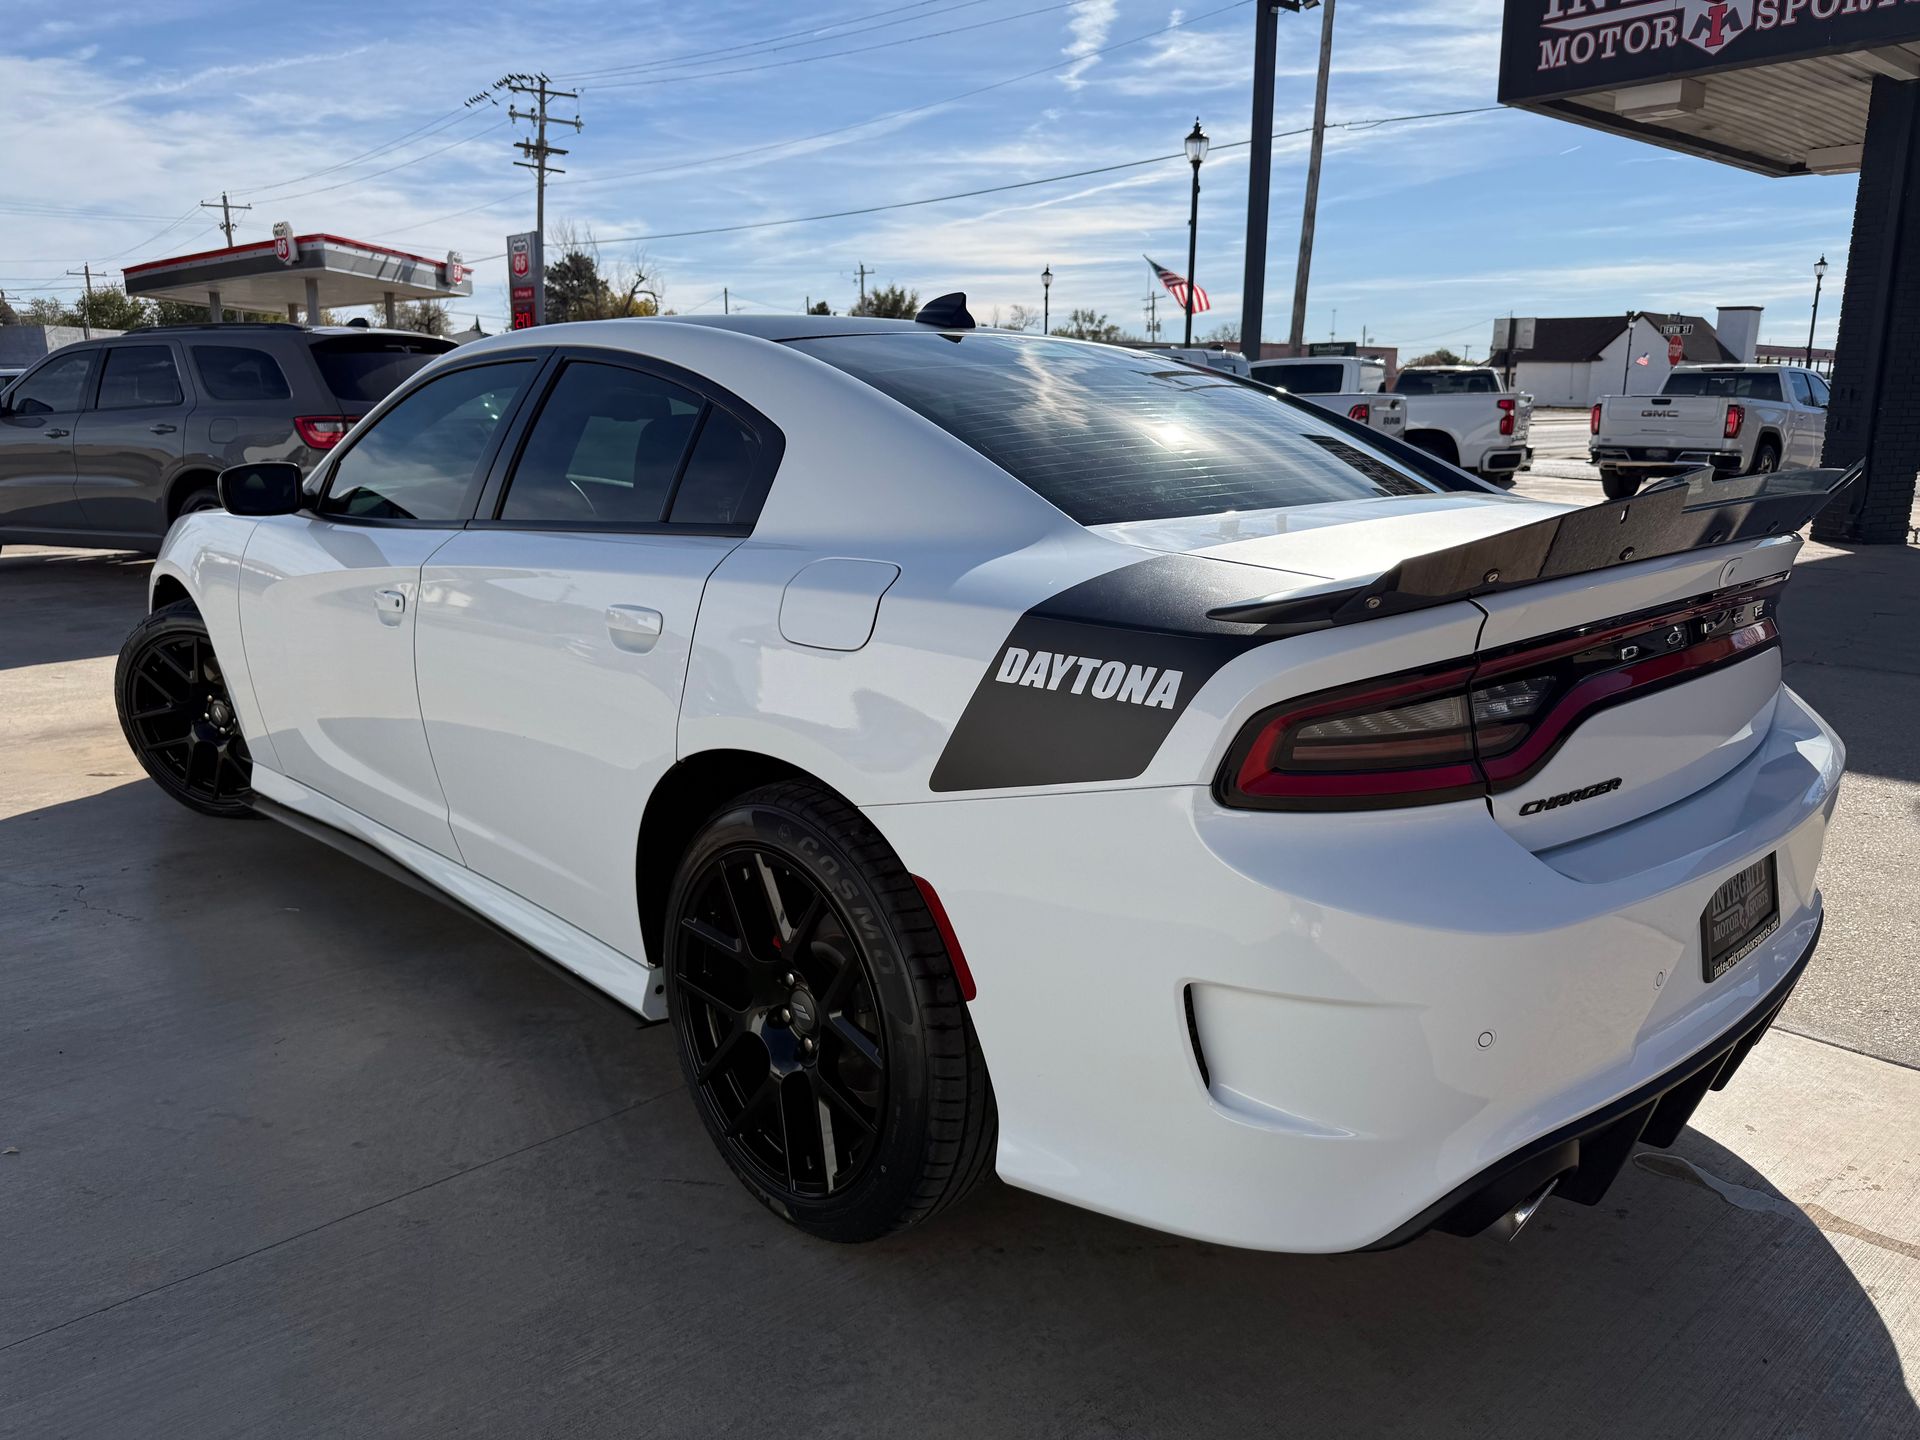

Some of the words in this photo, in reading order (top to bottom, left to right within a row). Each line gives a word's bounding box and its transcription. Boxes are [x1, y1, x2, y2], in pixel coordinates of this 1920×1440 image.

[1537, 16, 1677, 71] MOTOR
[515, 254, 526, 271] 66
[1669, 344, 1682, 356] STOP
[1621, 606, 1763, 660] DODGE
[995, 647, 1184, 710] DAYTONA
[1519, 777, 1622, 816] CHARGER
[799, 836, 896, 974] COSMO
[1712, 861, 1766, 915] INTEGRITY
[1713, 911, 1739, 942] MOTOR
[1749, 889, 1769, 915] SPORTS
[1714, 916, 1779, 979] integritymotorsports.net
